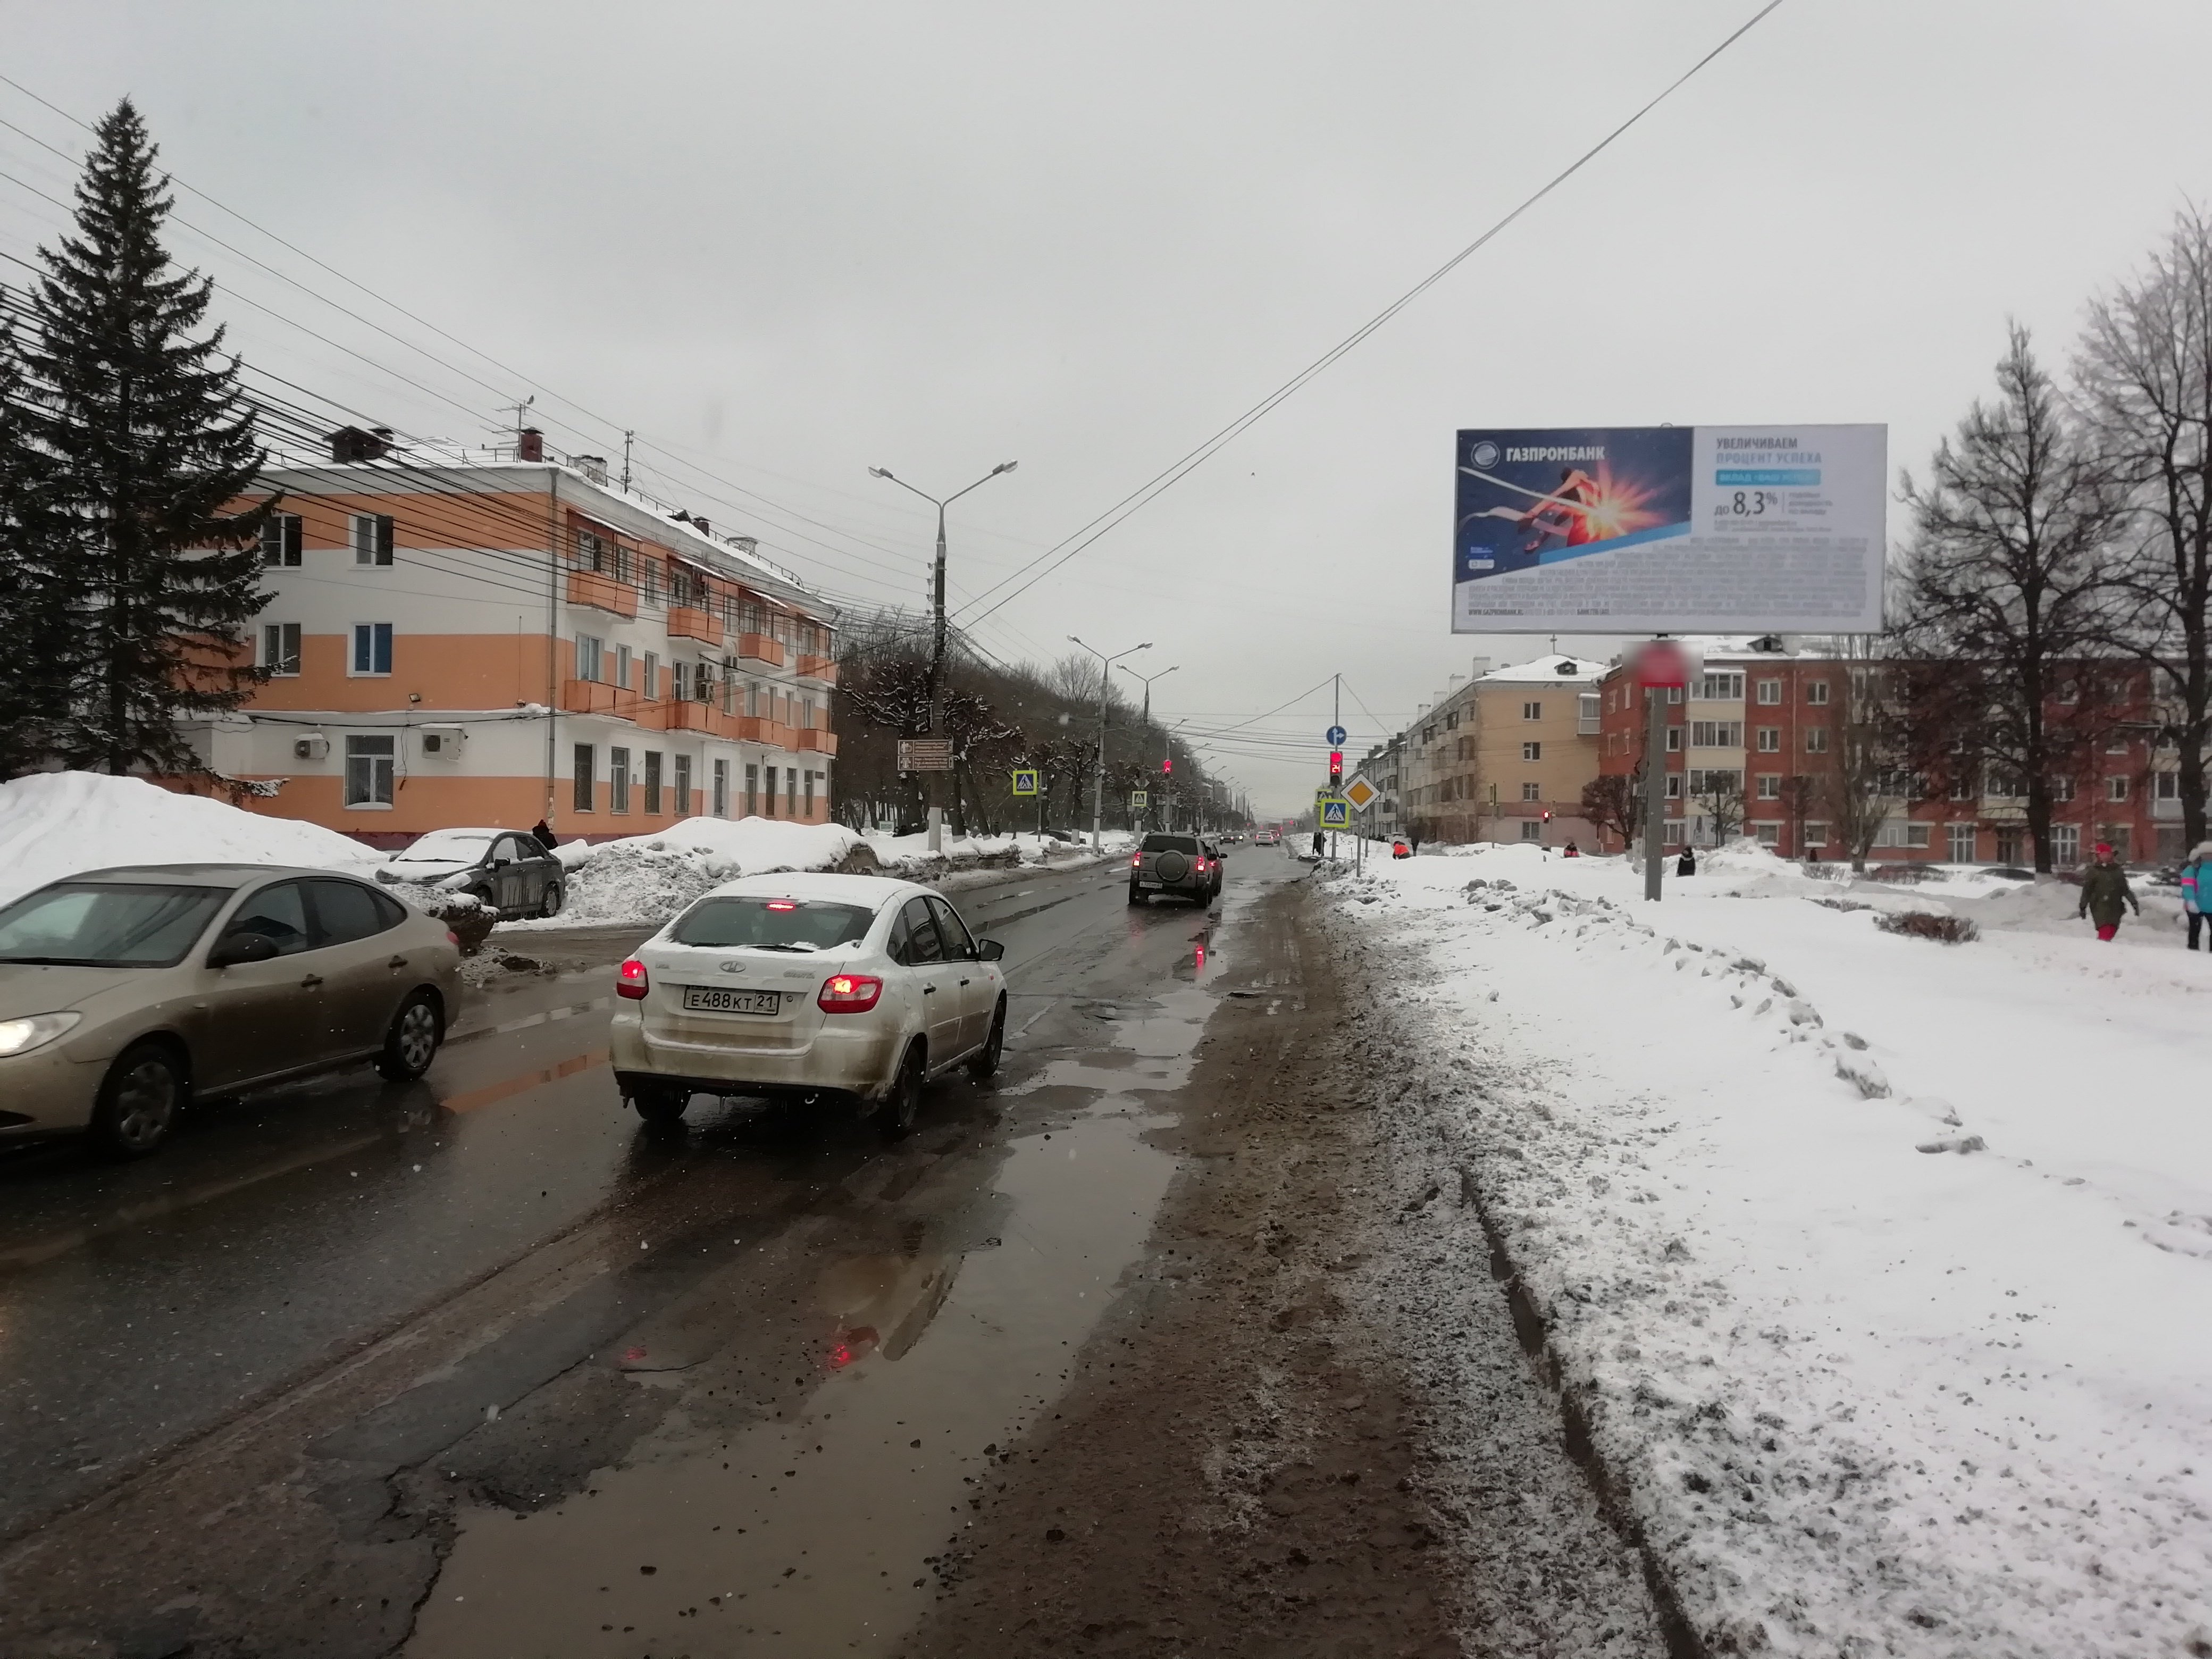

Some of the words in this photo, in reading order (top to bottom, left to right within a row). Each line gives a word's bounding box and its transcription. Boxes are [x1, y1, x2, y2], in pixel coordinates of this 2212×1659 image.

[1716, 437, 1798, 449] УВЕЛИЧИВАЕМ
[1506, 446, 1605, 462] ГАЗПРОМБАНК
[1716, 453, 1772, 465] ПРОЦЕНТ
[1777, 452, 1822, 464] УСПЕХА
[1332, 764, 1340, 773] 24
